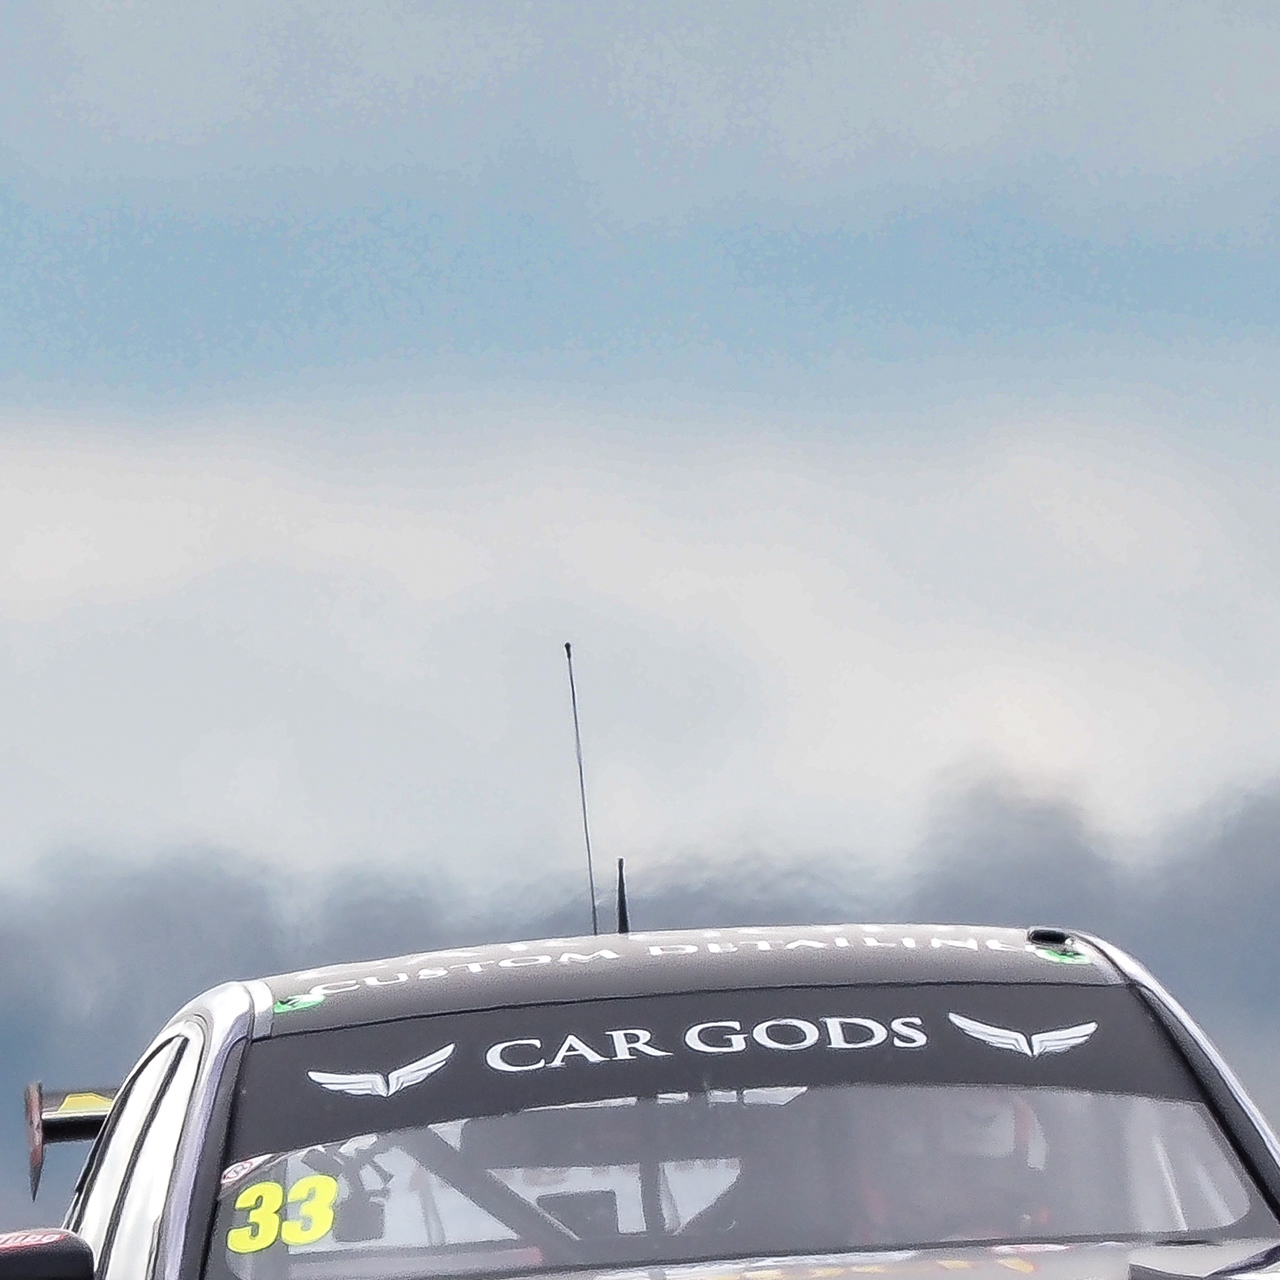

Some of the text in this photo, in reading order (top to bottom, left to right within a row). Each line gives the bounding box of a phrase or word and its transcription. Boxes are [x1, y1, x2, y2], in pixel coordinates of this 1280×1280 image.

[485, 1016, 928, 1073] CAR GODS
[227, 1174, 338, 1254] 33
